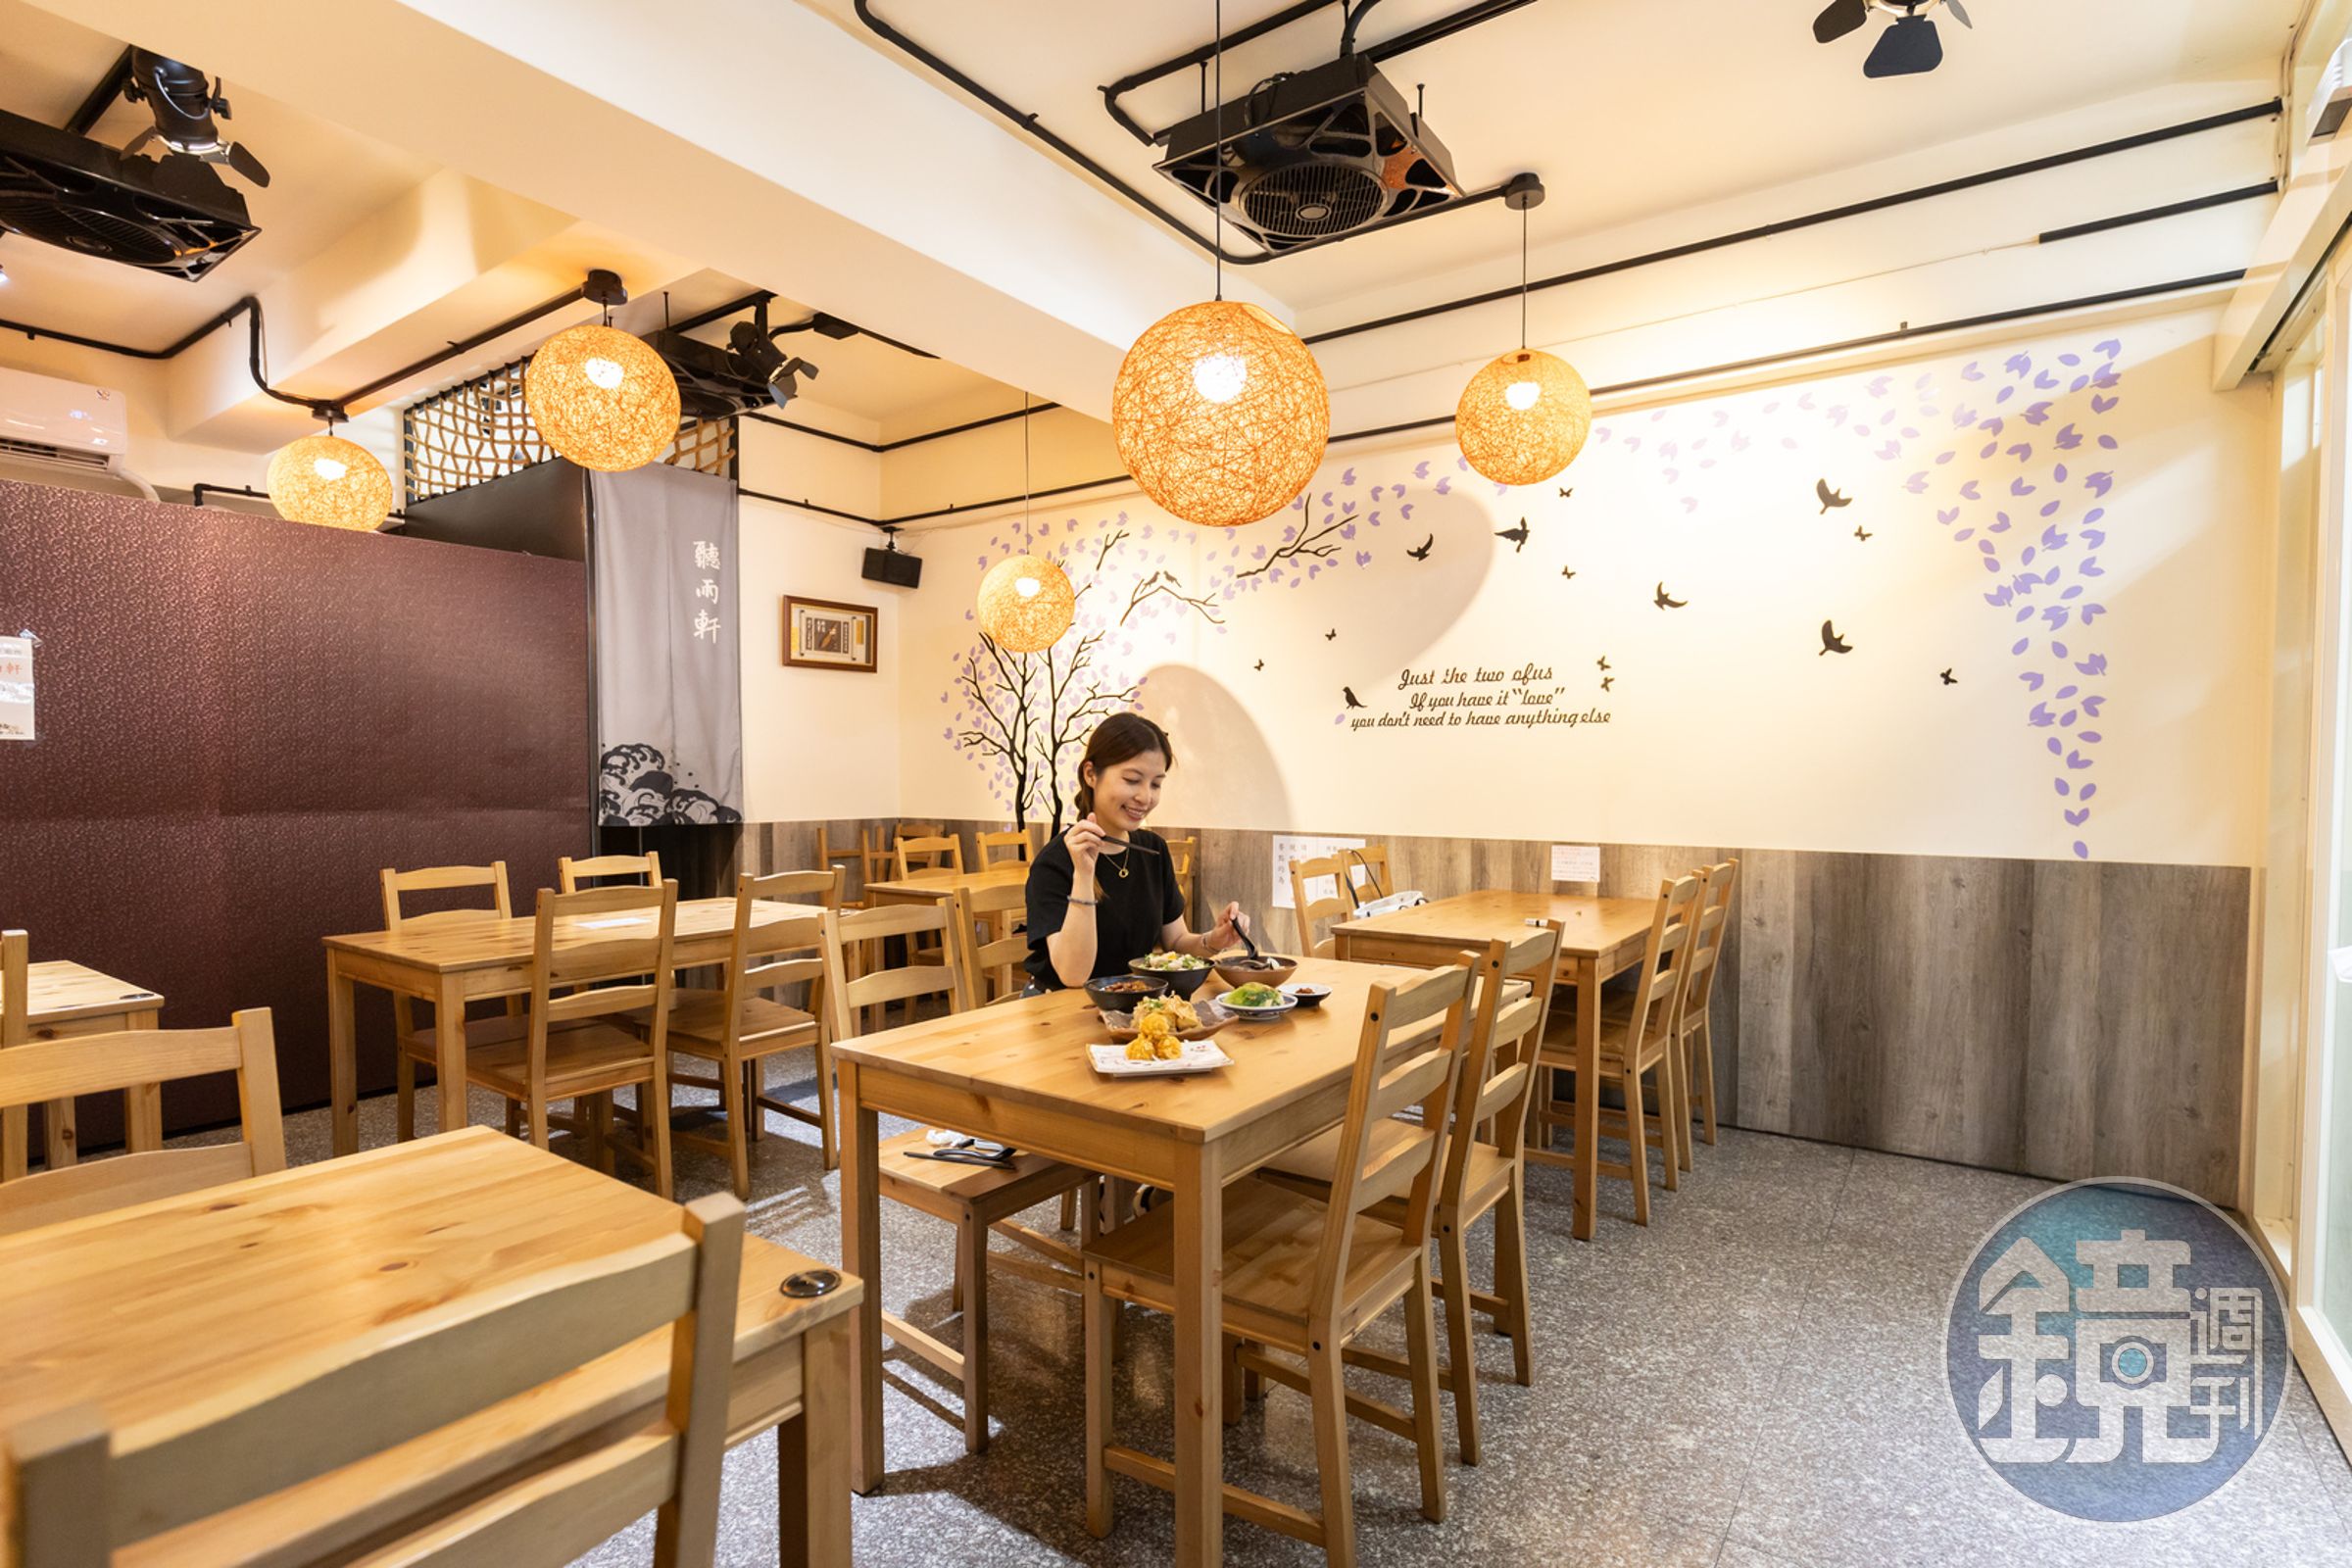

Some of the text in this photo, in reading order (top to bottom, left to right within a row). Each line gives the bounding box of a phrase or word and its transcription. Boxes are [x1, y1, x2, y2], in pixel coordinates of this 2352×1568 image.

[693, 540, 721, 644] 聽雨軒
[1397, 668, 1435, 690] Just
[1441, 666, 1467, 684] the
[1474, 666, 1504, 683] two
[1409, 692, 1428, 711] If
[1428, 696, 1454, 711] you
[1456, 691, 1493, 707] have
[1495, 689, 1509, 706] it
[1350, 707, 1611, 732] you don't need to have anything else
